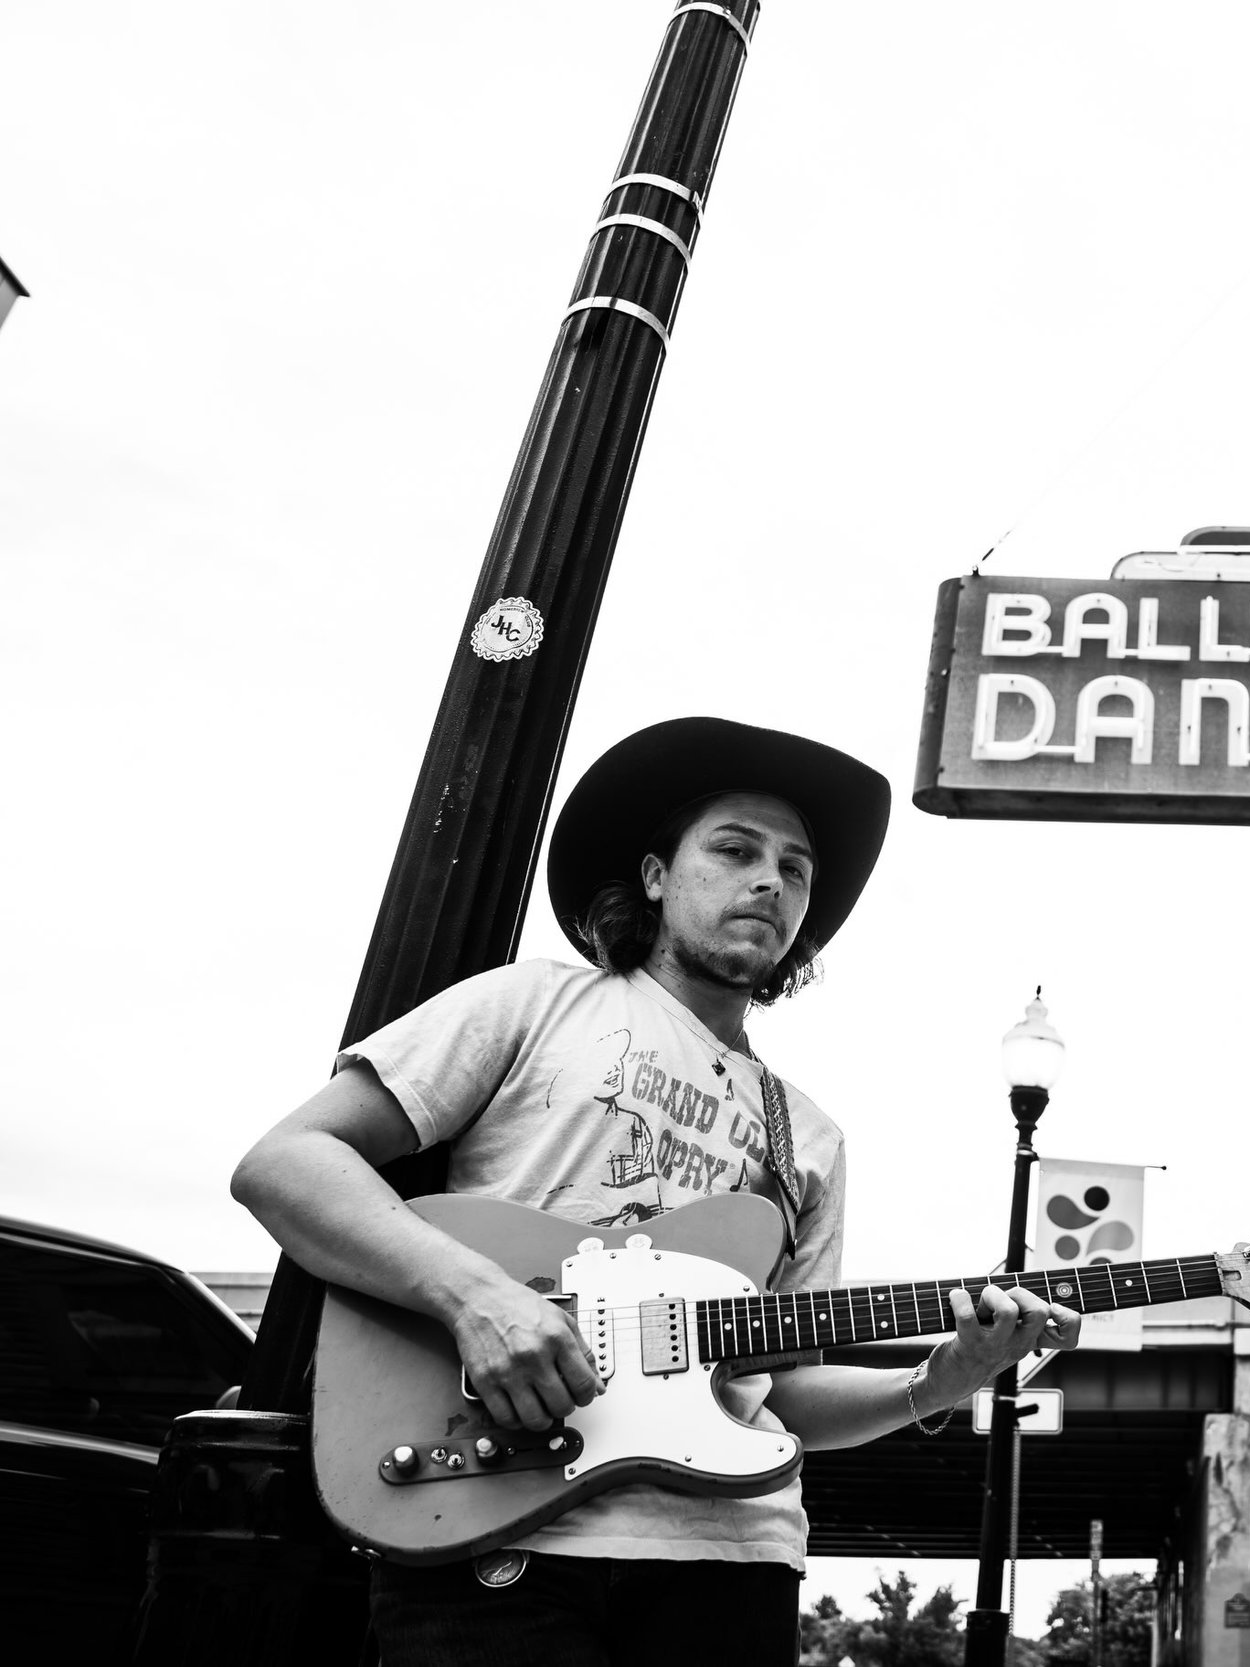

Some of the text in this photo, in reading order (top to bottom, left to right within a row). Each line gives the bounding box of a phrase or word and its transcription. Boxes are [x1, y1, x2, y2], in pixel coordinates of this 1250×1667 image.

[491, 615, 521, 642] JHC
[628, 1050, 659, 1063] THE
[631, 1062, 720, 1135] GRAND
[656, 1128, 729, 1195] OPRY
